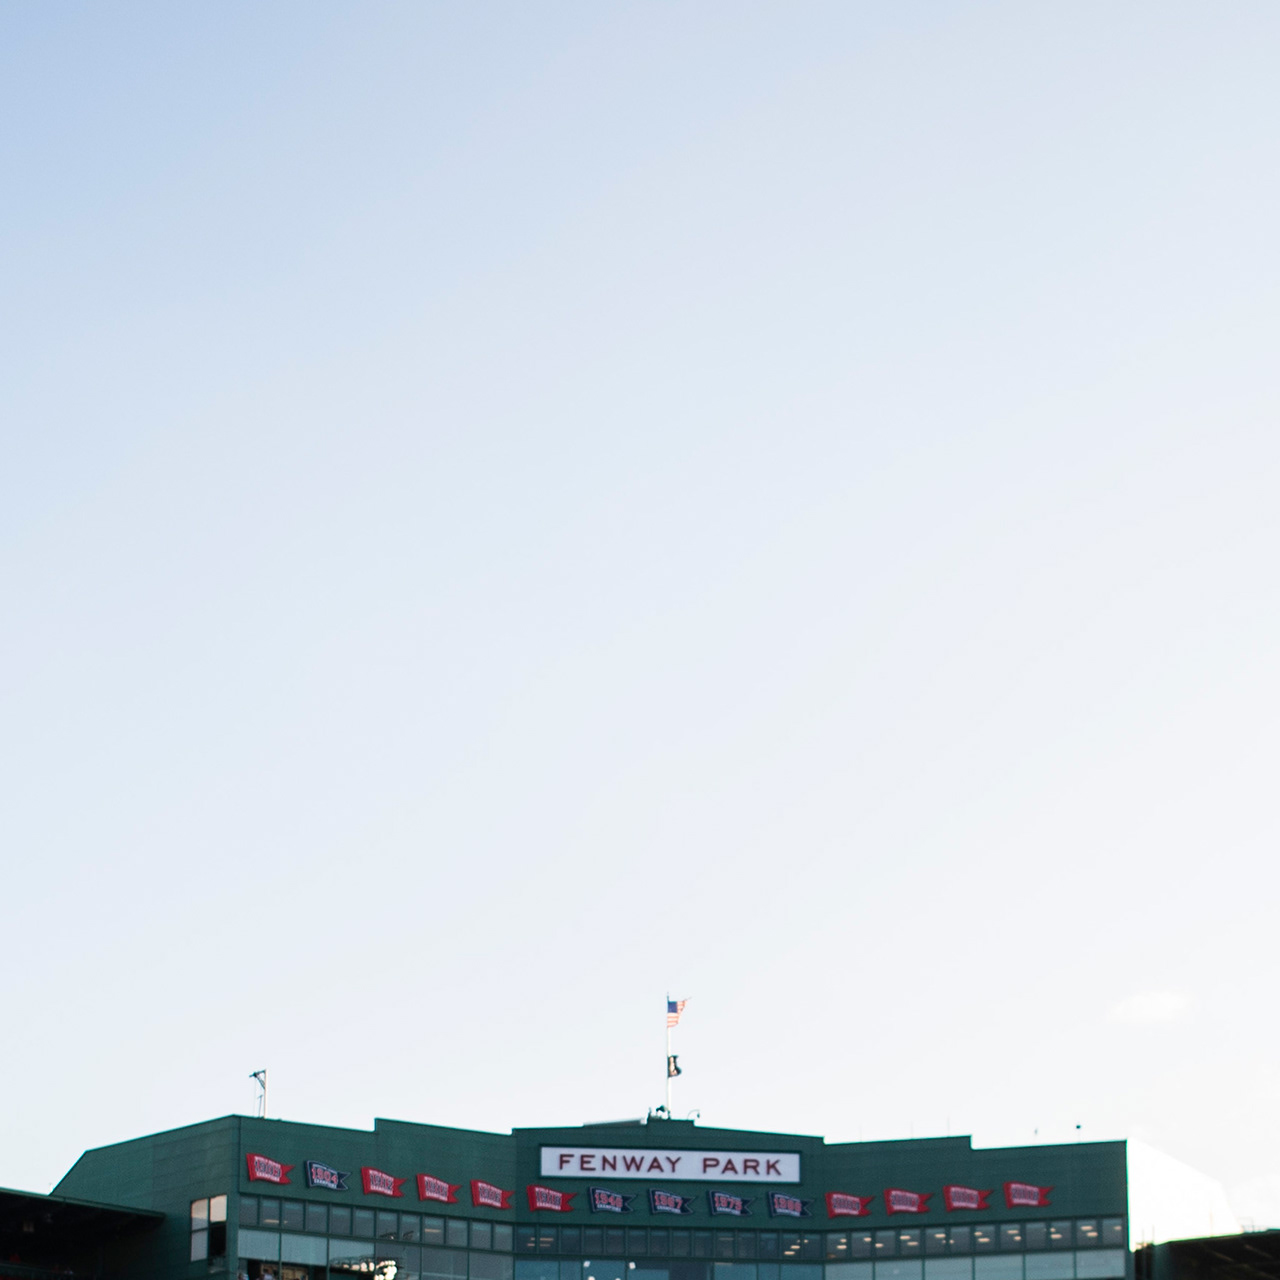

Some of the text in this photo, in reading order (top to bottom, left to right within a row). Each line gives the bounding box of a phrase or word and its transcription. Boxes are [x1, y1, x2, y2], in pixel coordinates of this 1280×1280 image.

[559, 1154, 782, 1176] FENWAY PARK
[311, 1166, 339, 1184] 1904
[653, 1193, 683, 1210] 1967
